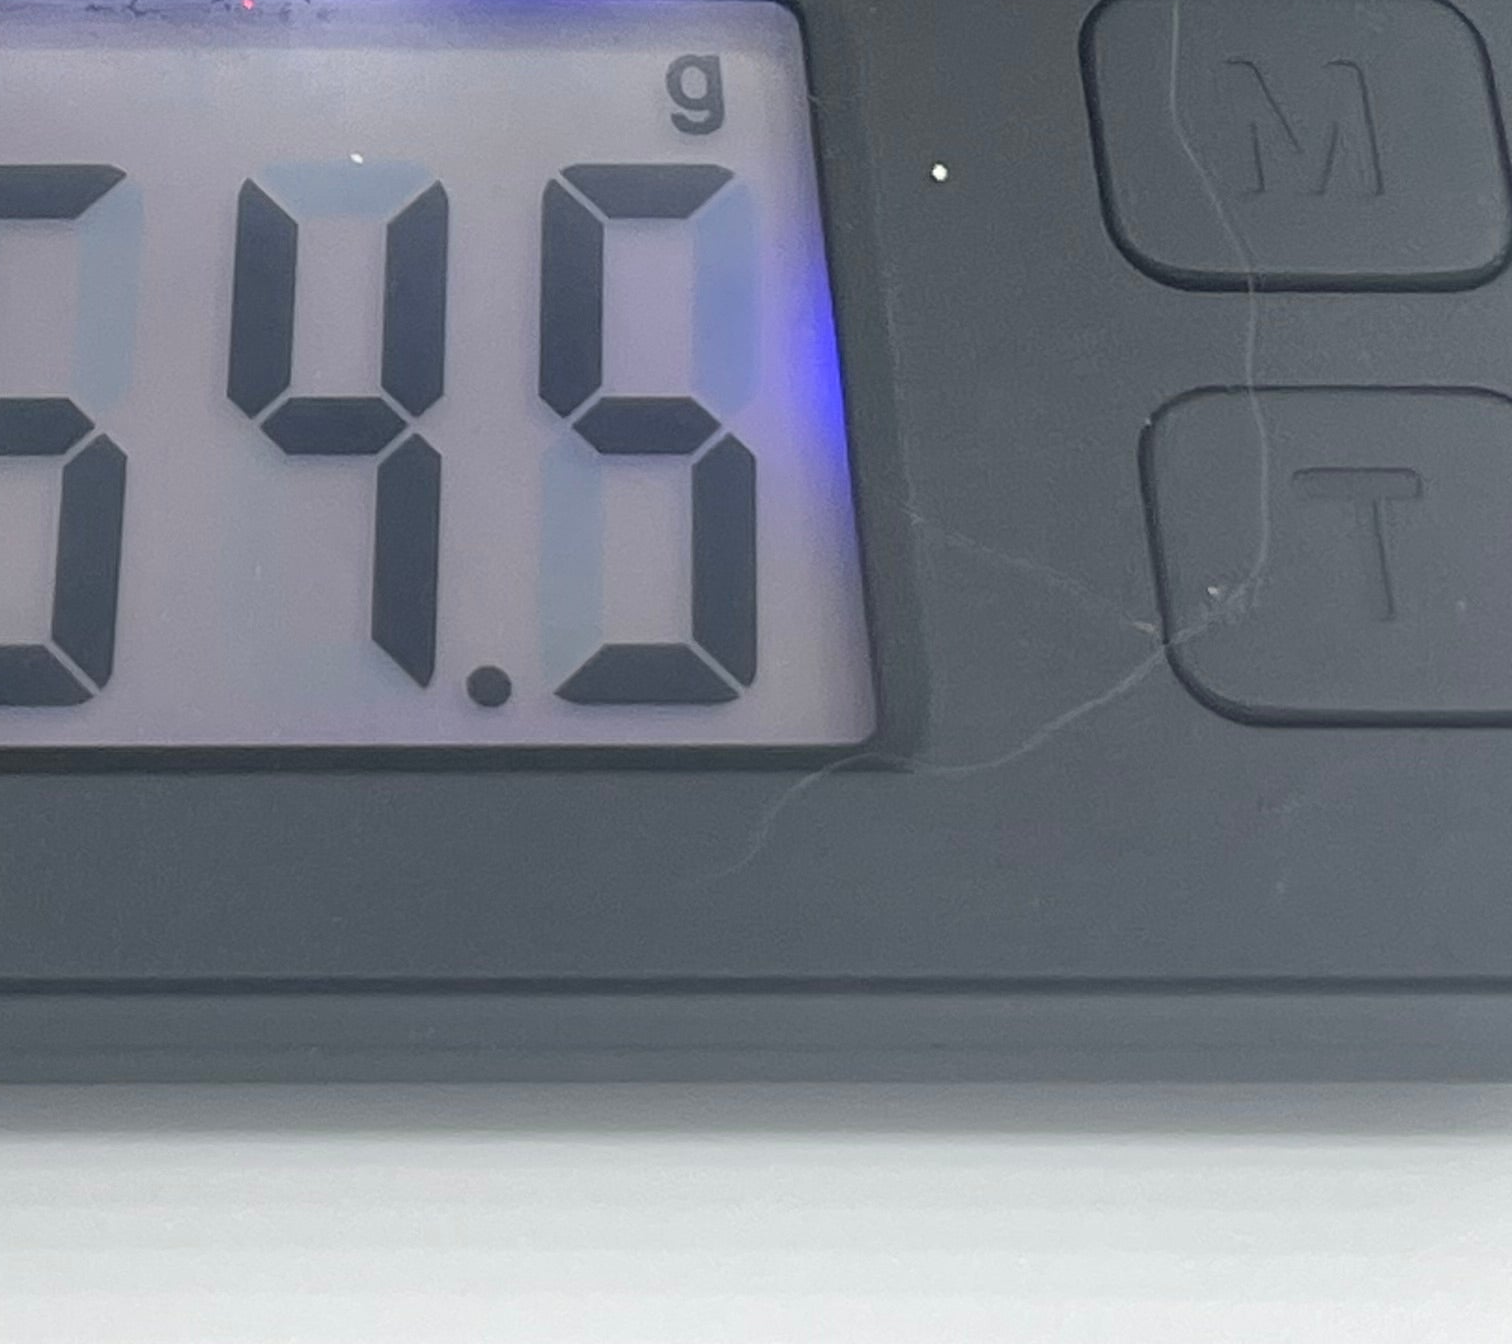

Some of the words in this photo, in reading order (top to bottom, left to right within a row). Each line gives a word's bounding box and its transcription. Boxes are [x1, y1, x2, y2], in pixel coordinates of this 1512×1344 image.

[665, 53, 725, 136] g
[1224, 59, 1385, 198] M
[1292, 466, 1424, 622] T
